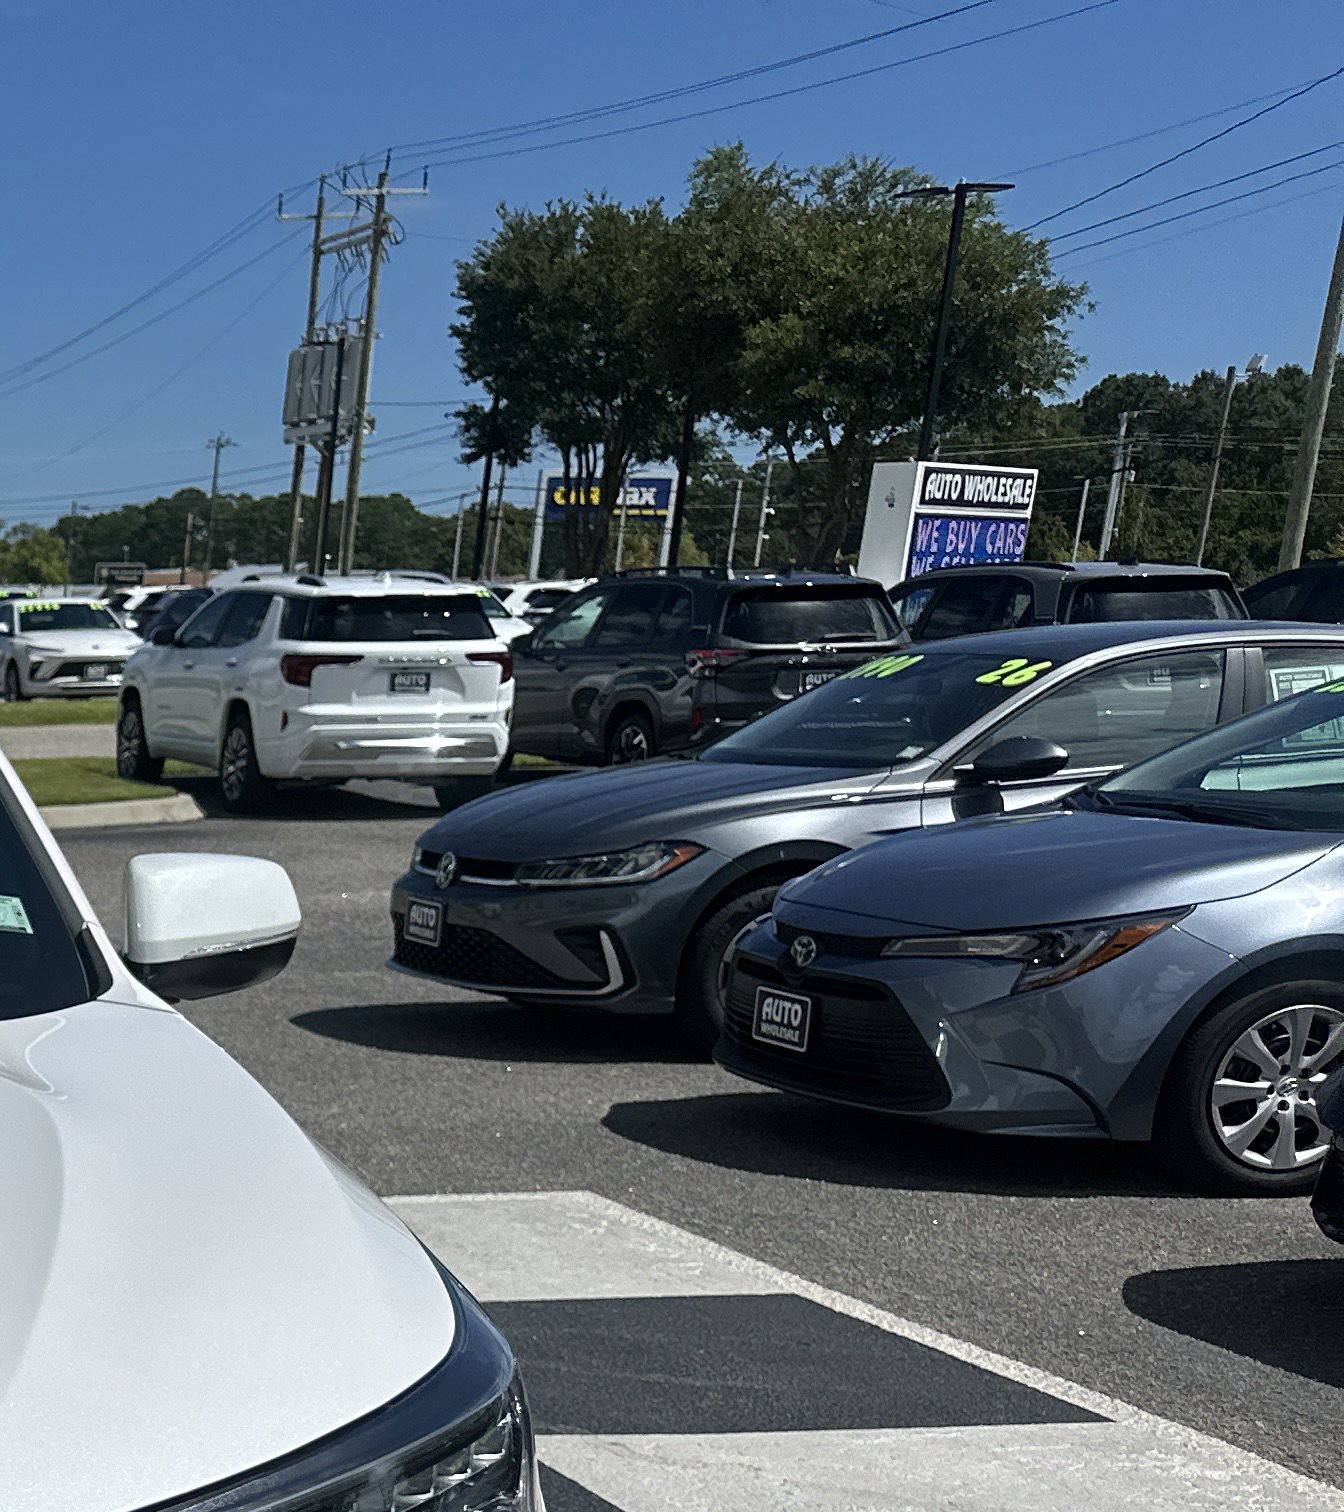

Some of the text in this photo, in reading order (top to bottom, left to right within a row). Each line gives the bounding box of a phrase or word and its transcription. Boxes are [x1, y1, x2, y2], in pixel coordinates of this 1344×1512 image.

[925, 472, 1032, 505] AUTO WHOLESALE
[916, 519, 1026, 555] WE BUY CARS
[394, 674, 427, 687] AUTO
[805, 672, 837, 686] AUT
[975, 658, 1053, 687] 26
[410, 904, 437, 928] AUTO
[762, 997, 802, 1027] AUTO
